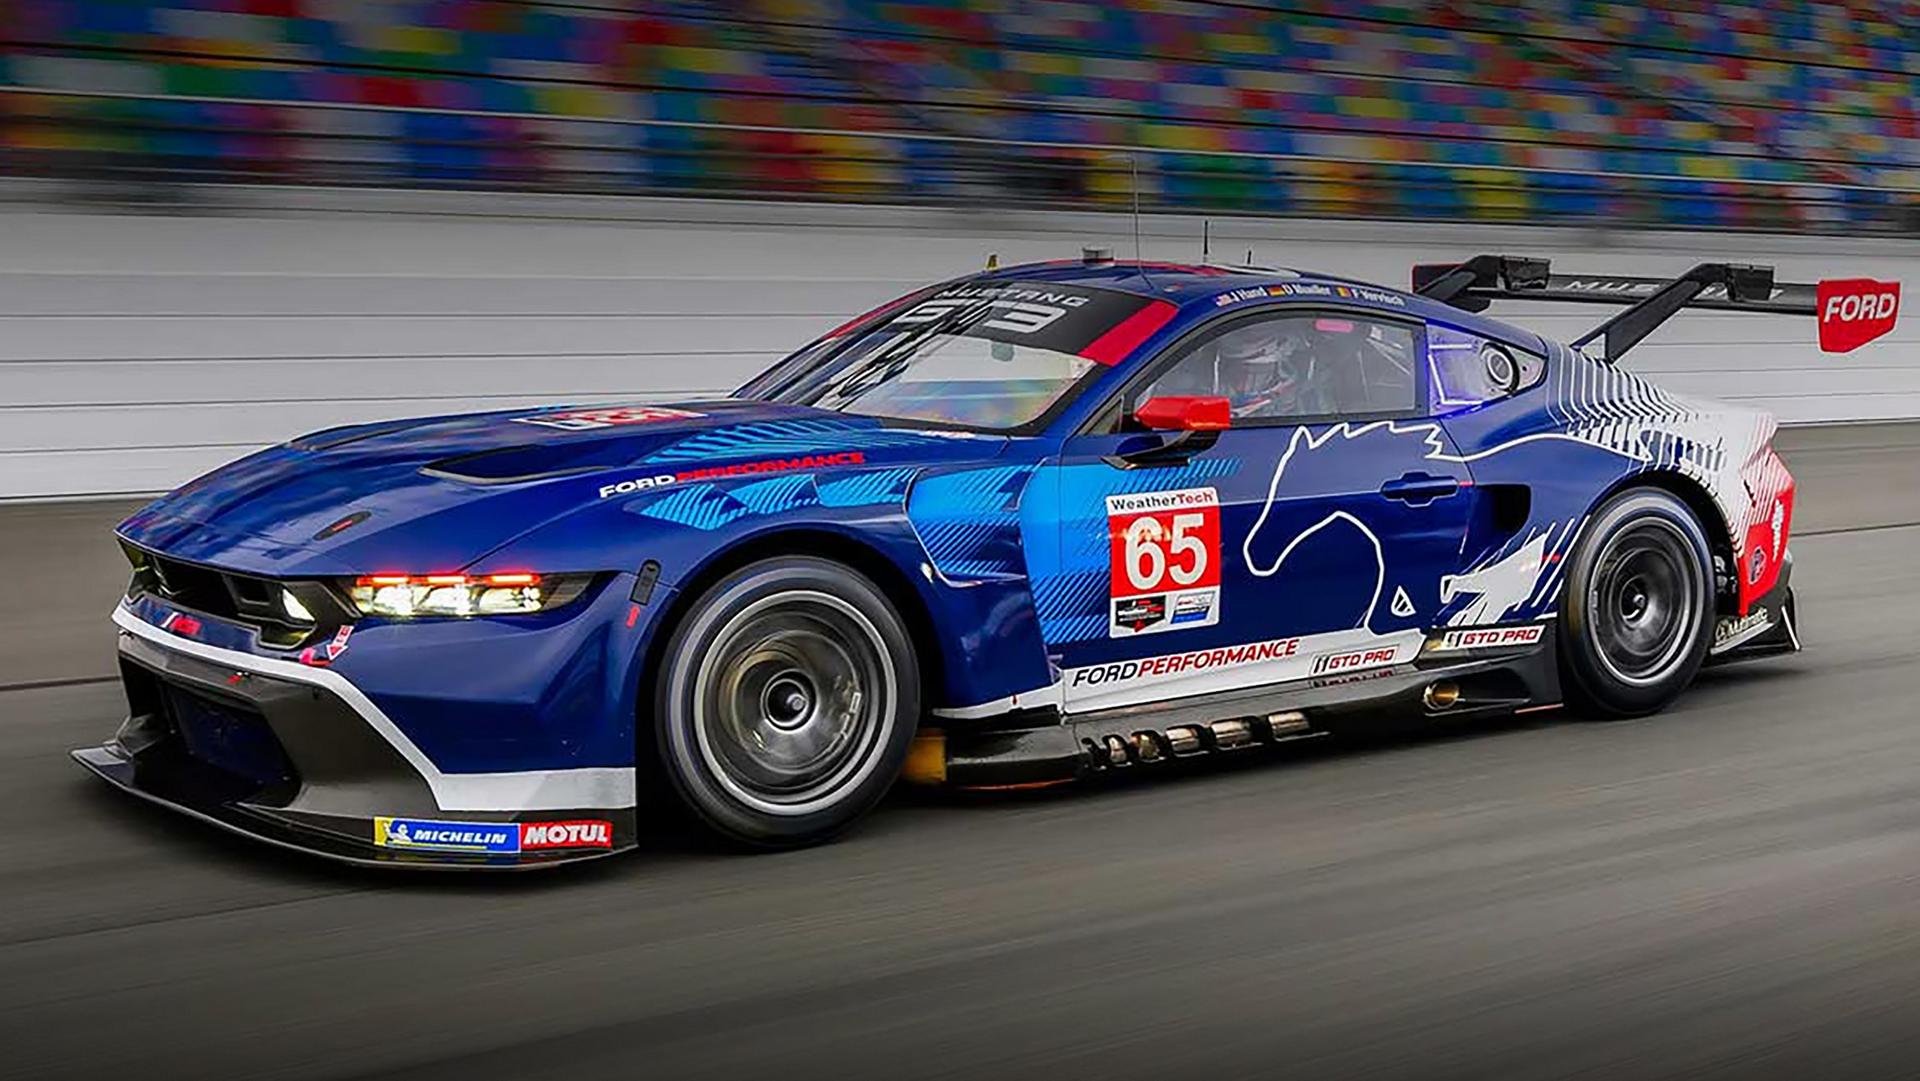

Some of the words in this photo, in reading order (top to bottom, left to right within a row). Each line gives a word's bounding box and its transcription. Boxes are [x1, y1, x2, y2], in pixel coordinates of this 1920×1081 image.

[1236, 286, 1267, 301] Hand
[1823, 292, 1896, 323] FORD
[1111, 491, 1213, 511] WeatherTech
[1125, 512, 1208, 591] 65
[1462, 632, 1499, 645] GTD
[1499, 629, 1540, 642] PRO
[1328, 654, 1361, 669] GTD
[1362, 649, 1395, 664] PRO
[413, 829, 507, 845] MICHELIN
[523, 824, 609, 844] MOTUL
